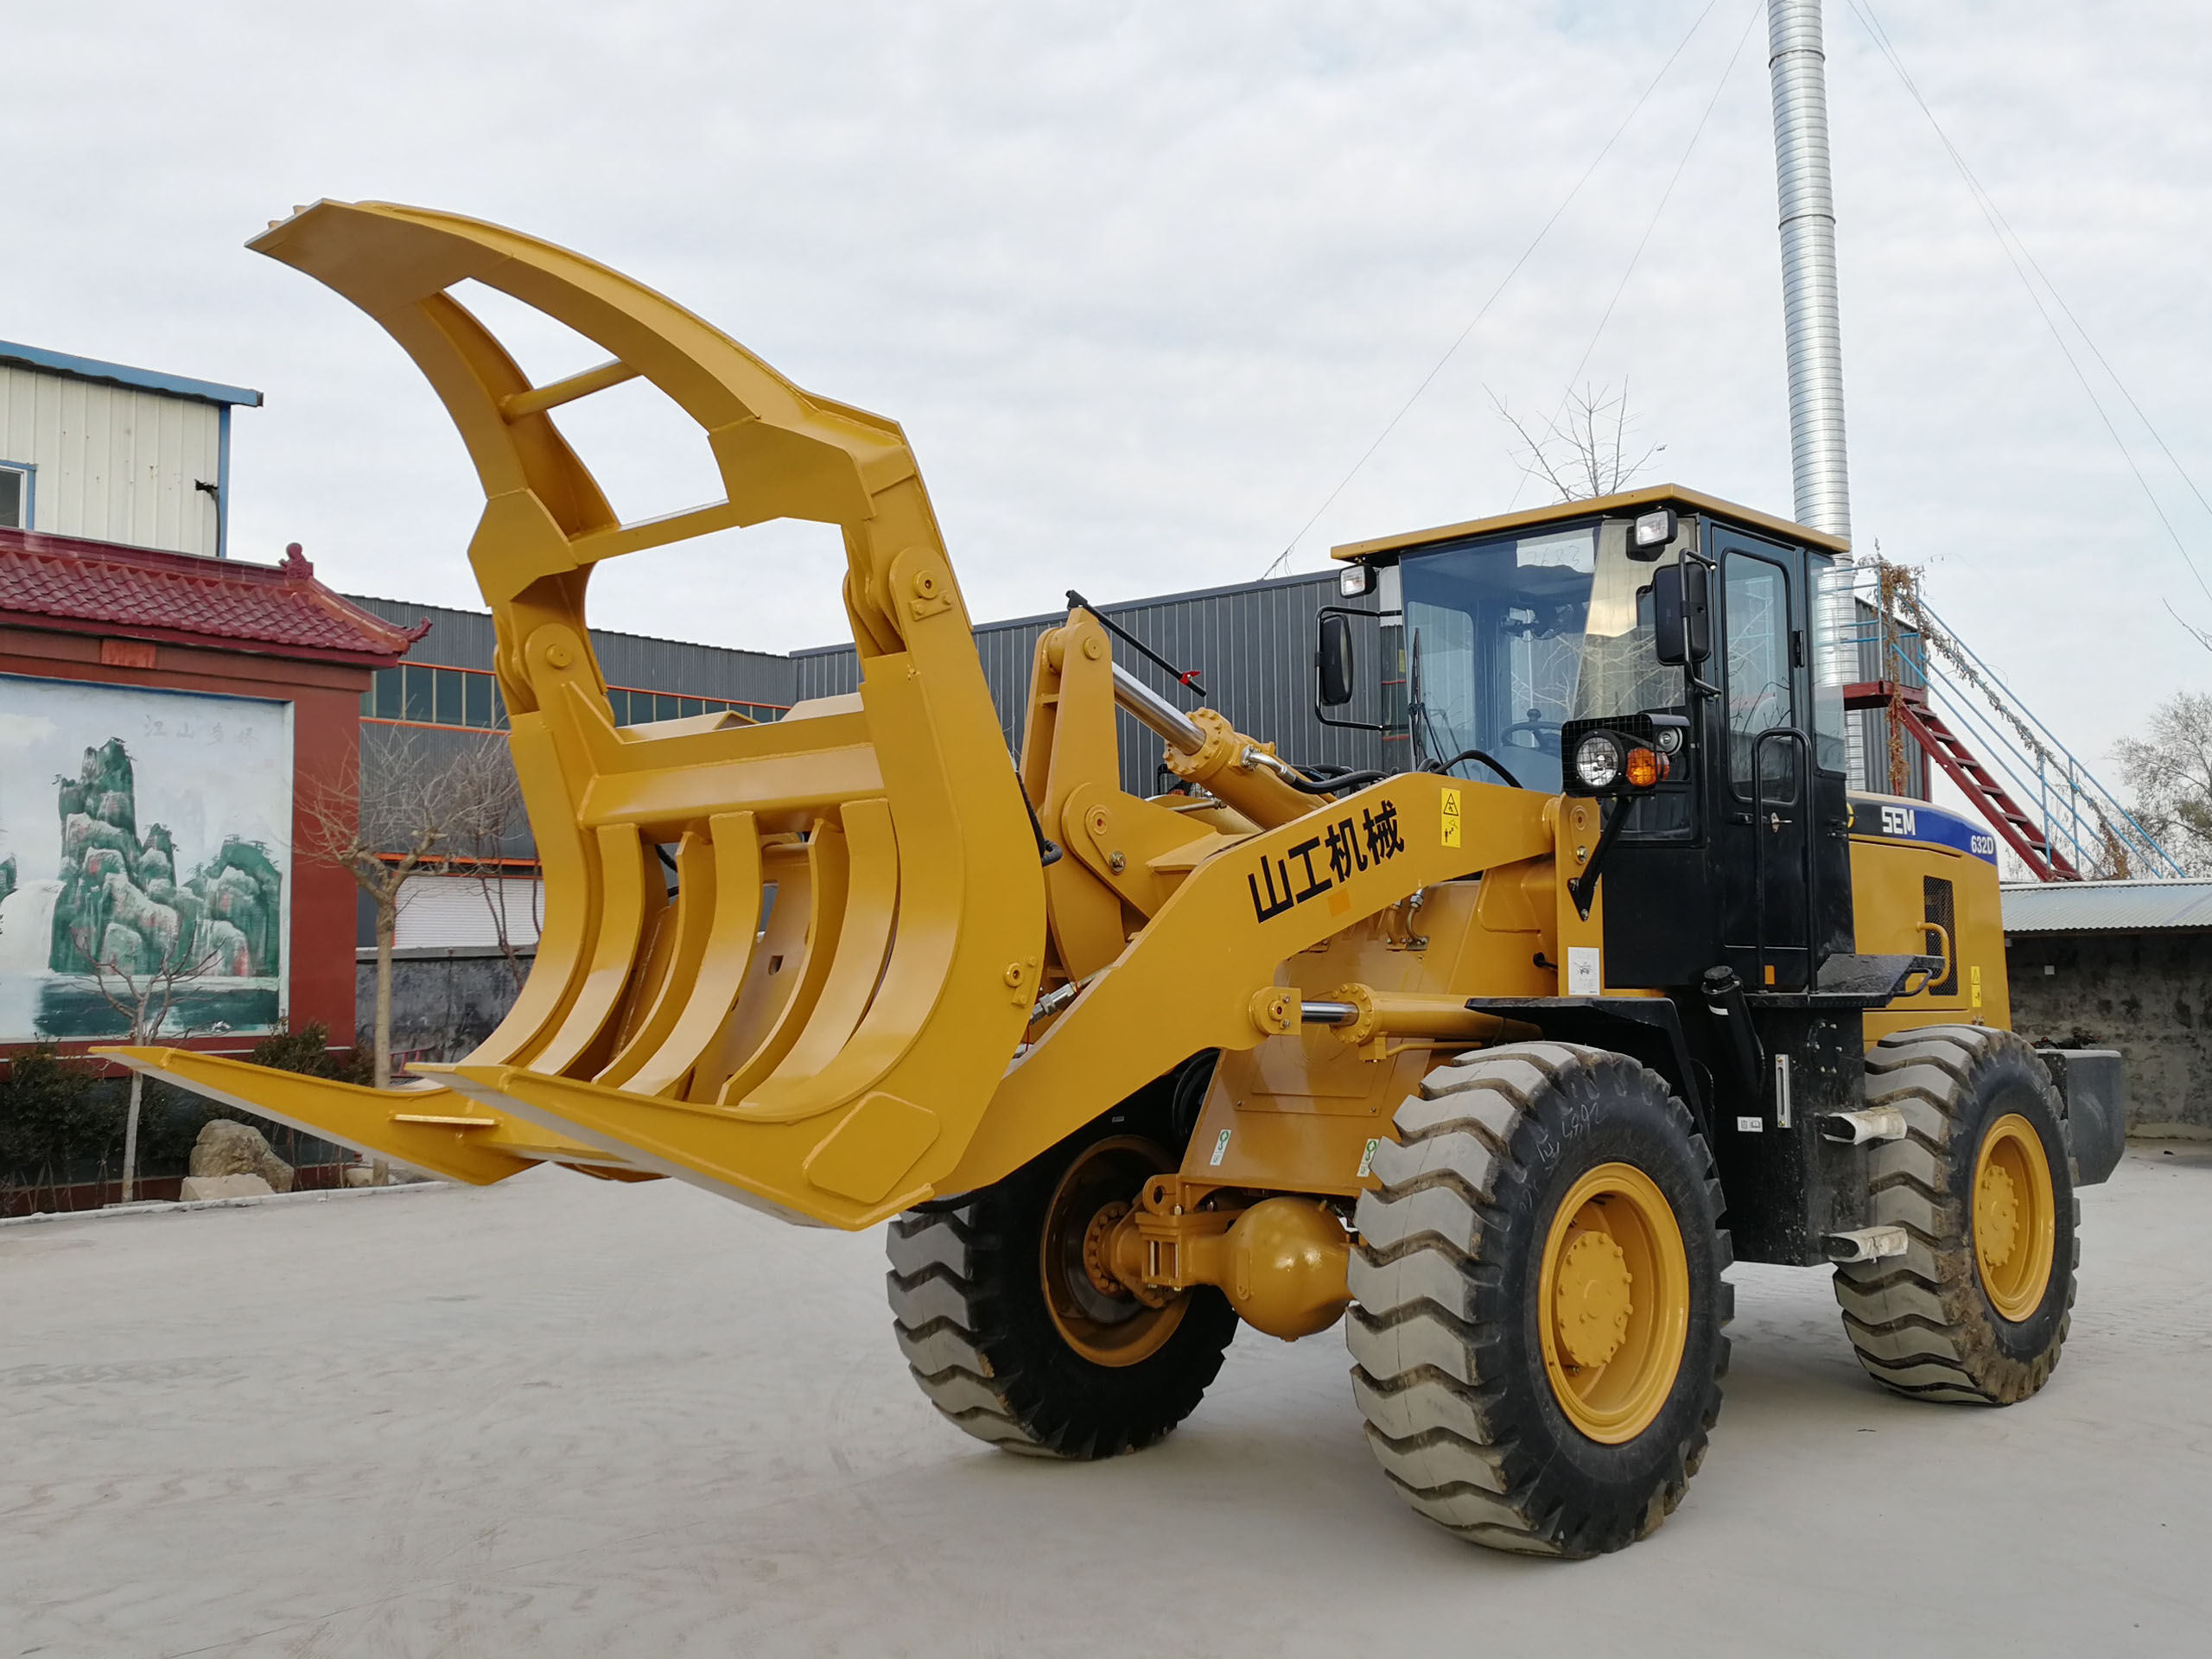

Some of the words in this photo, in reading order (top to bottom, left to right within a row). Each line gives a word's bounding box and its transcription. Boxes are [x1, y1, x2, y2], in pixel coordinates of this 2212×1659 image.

[1881, 805, 1916, 836] SEM
[1971, 835, 1994, 855] 632D
[1248, 800, 1404, 924] 山工机械
